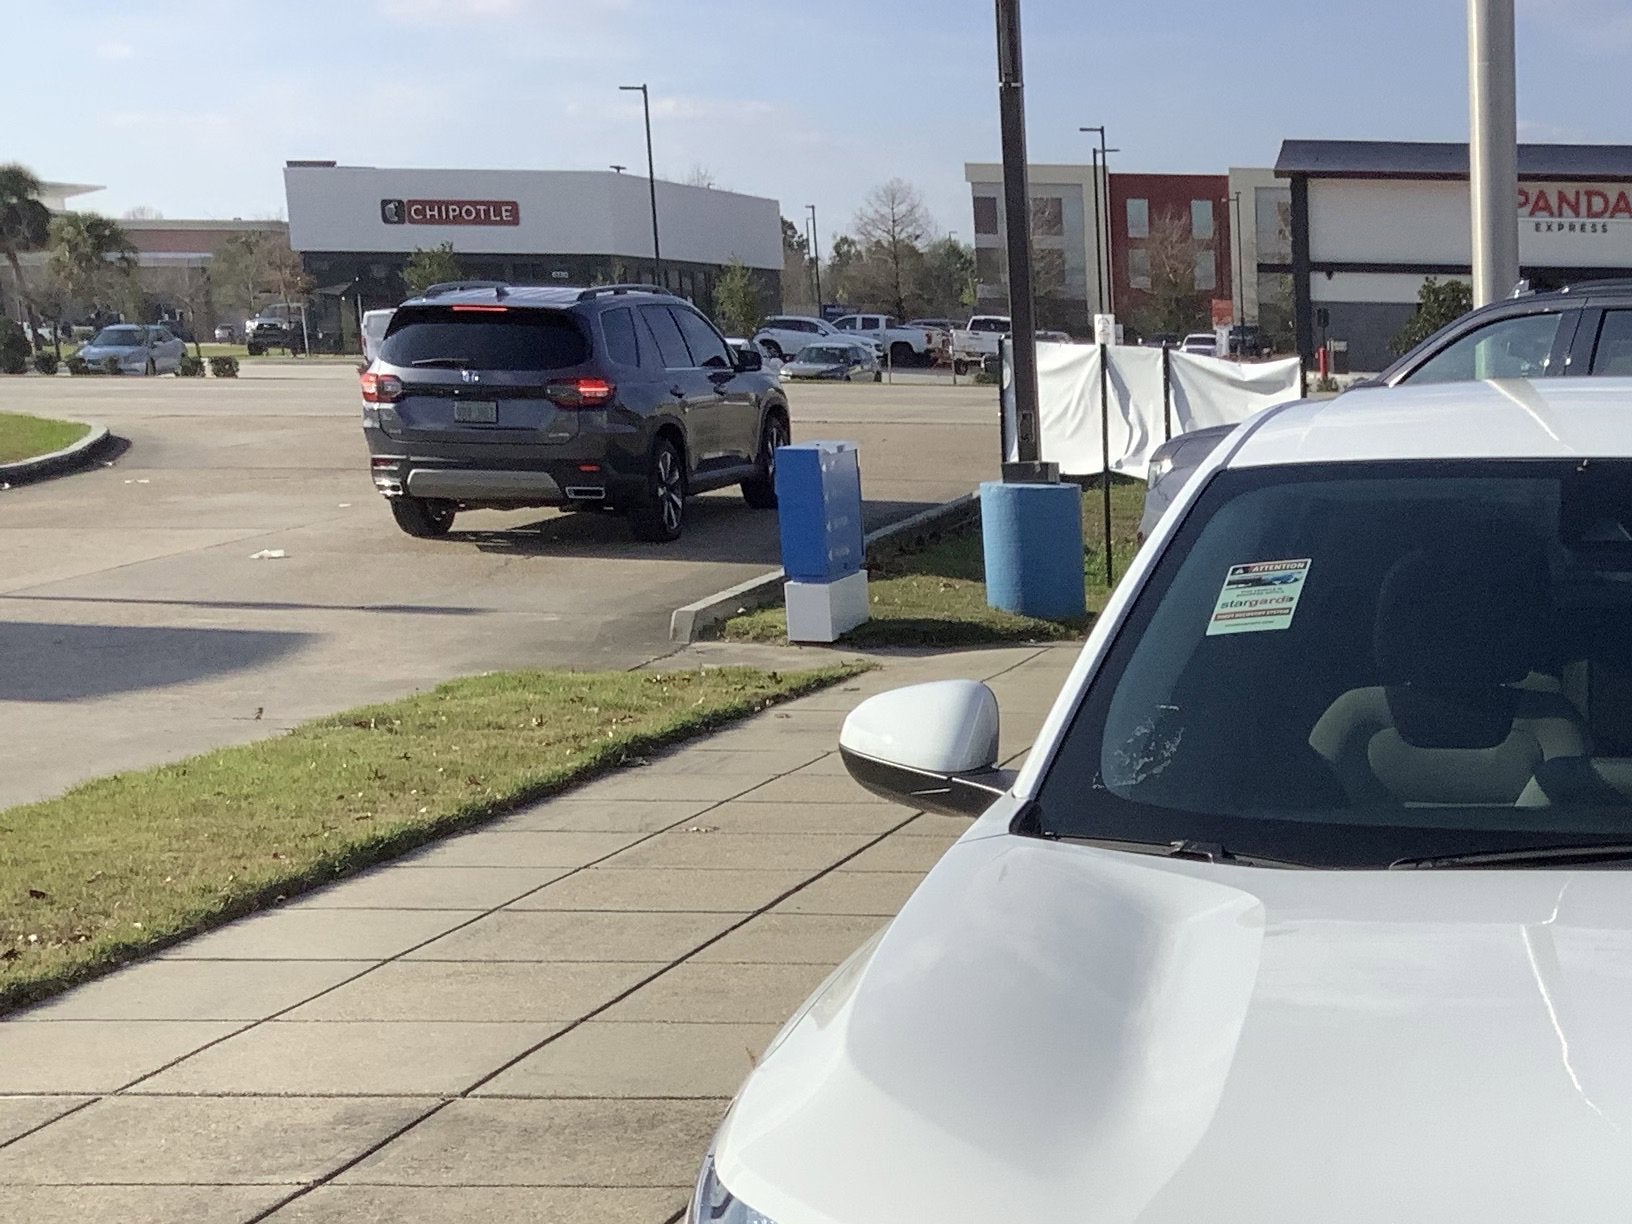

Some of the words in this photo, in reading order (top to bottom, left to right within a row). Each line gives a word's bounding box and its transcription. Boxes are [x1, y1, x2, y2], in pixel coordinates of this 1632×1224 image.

[410, 204, 513, 221] CHIPOTLE
[1535, 222, 1609, 234] EXPRESS
[1252, 561, 1305, 573] ATTENTION
